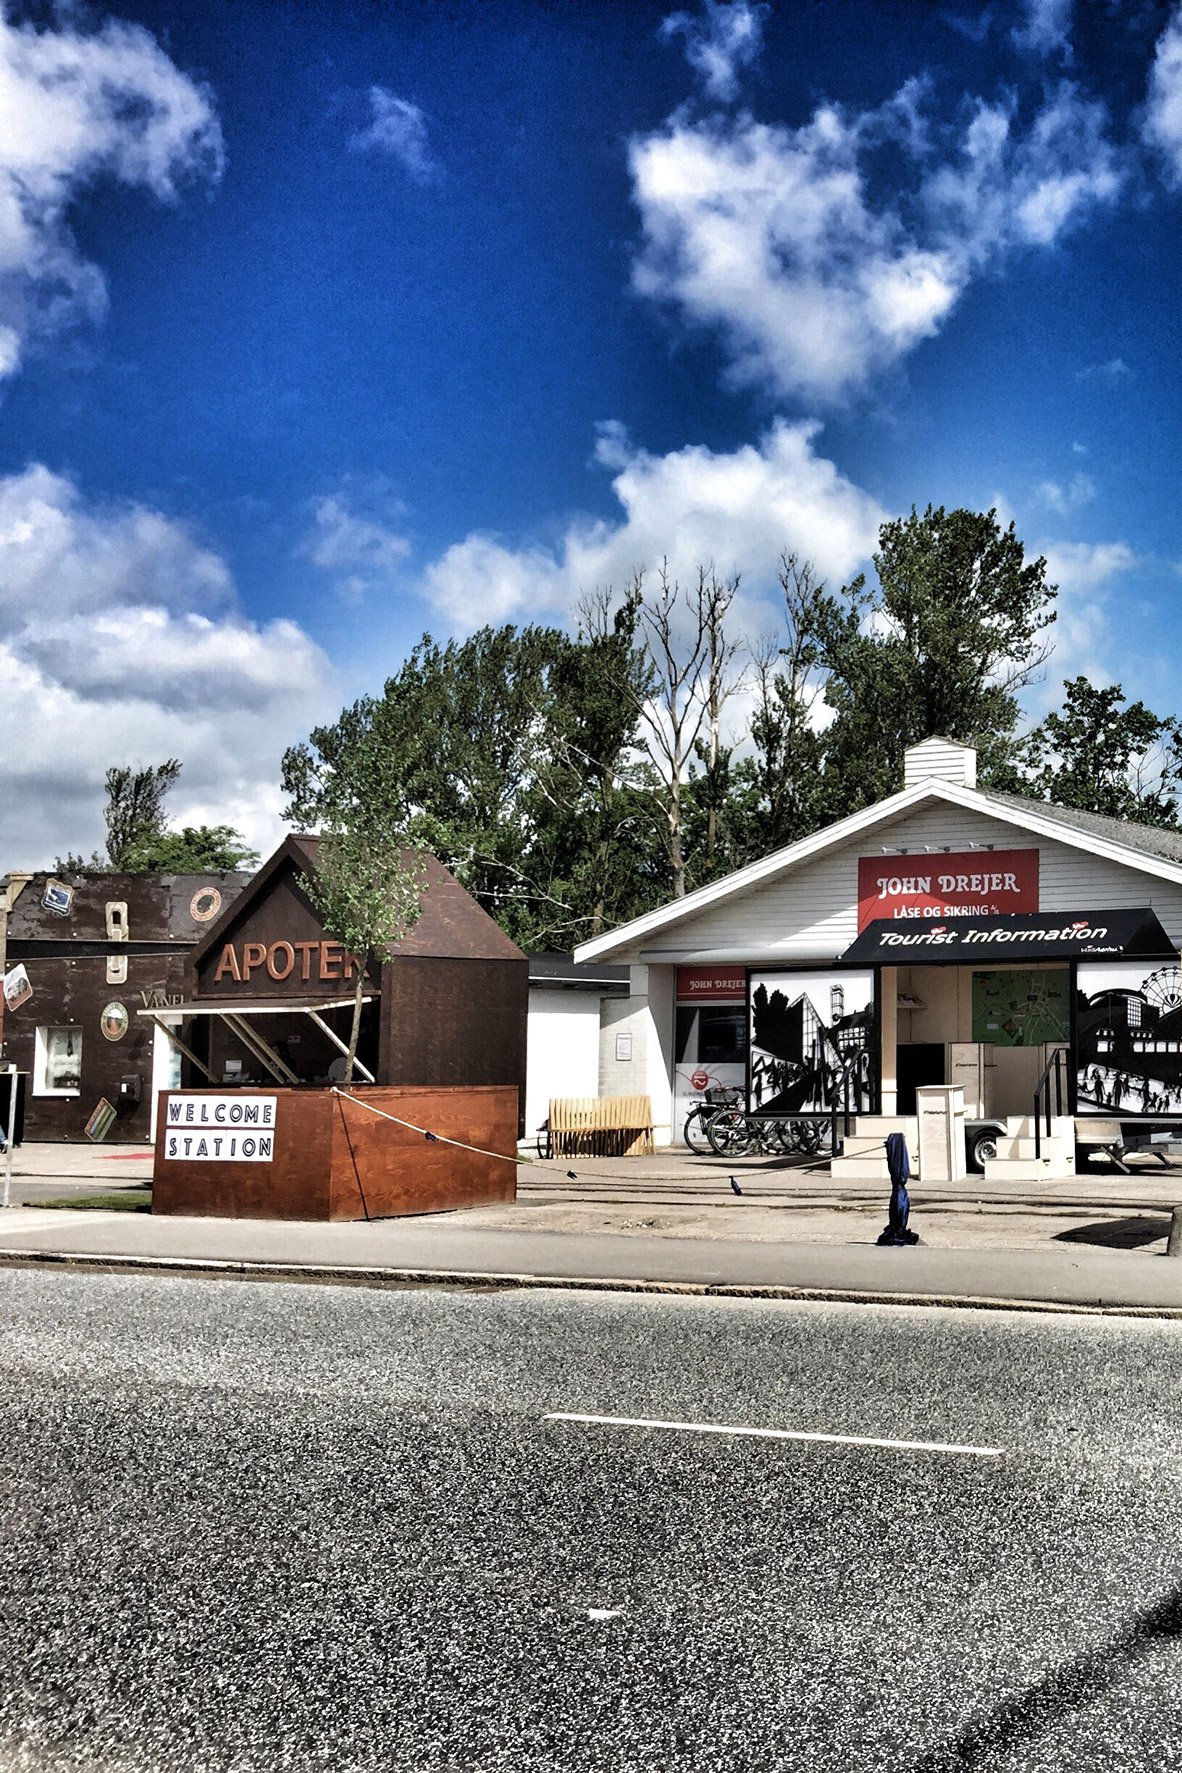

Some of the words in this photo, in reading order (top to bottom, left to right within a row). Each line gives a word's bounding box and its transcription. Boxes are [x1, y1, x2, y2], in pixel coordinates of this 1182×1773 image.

[876, 876, 932, 900] JOHN
[937, 873, 1021, 896] DREJER
[893, 904, 921, 919] LÅSE
[923, 906, 941, 917] OG
[943, 904, 989, 917] SIKRING
[878, 926, 959, 946] Tourist
[961, 921, 1108, 944] Information
[689, 980, 713, 991] JOHN
[169, 1103, 272, 1123] WELCOME
[168, 1137, 272, 1157] STATION
